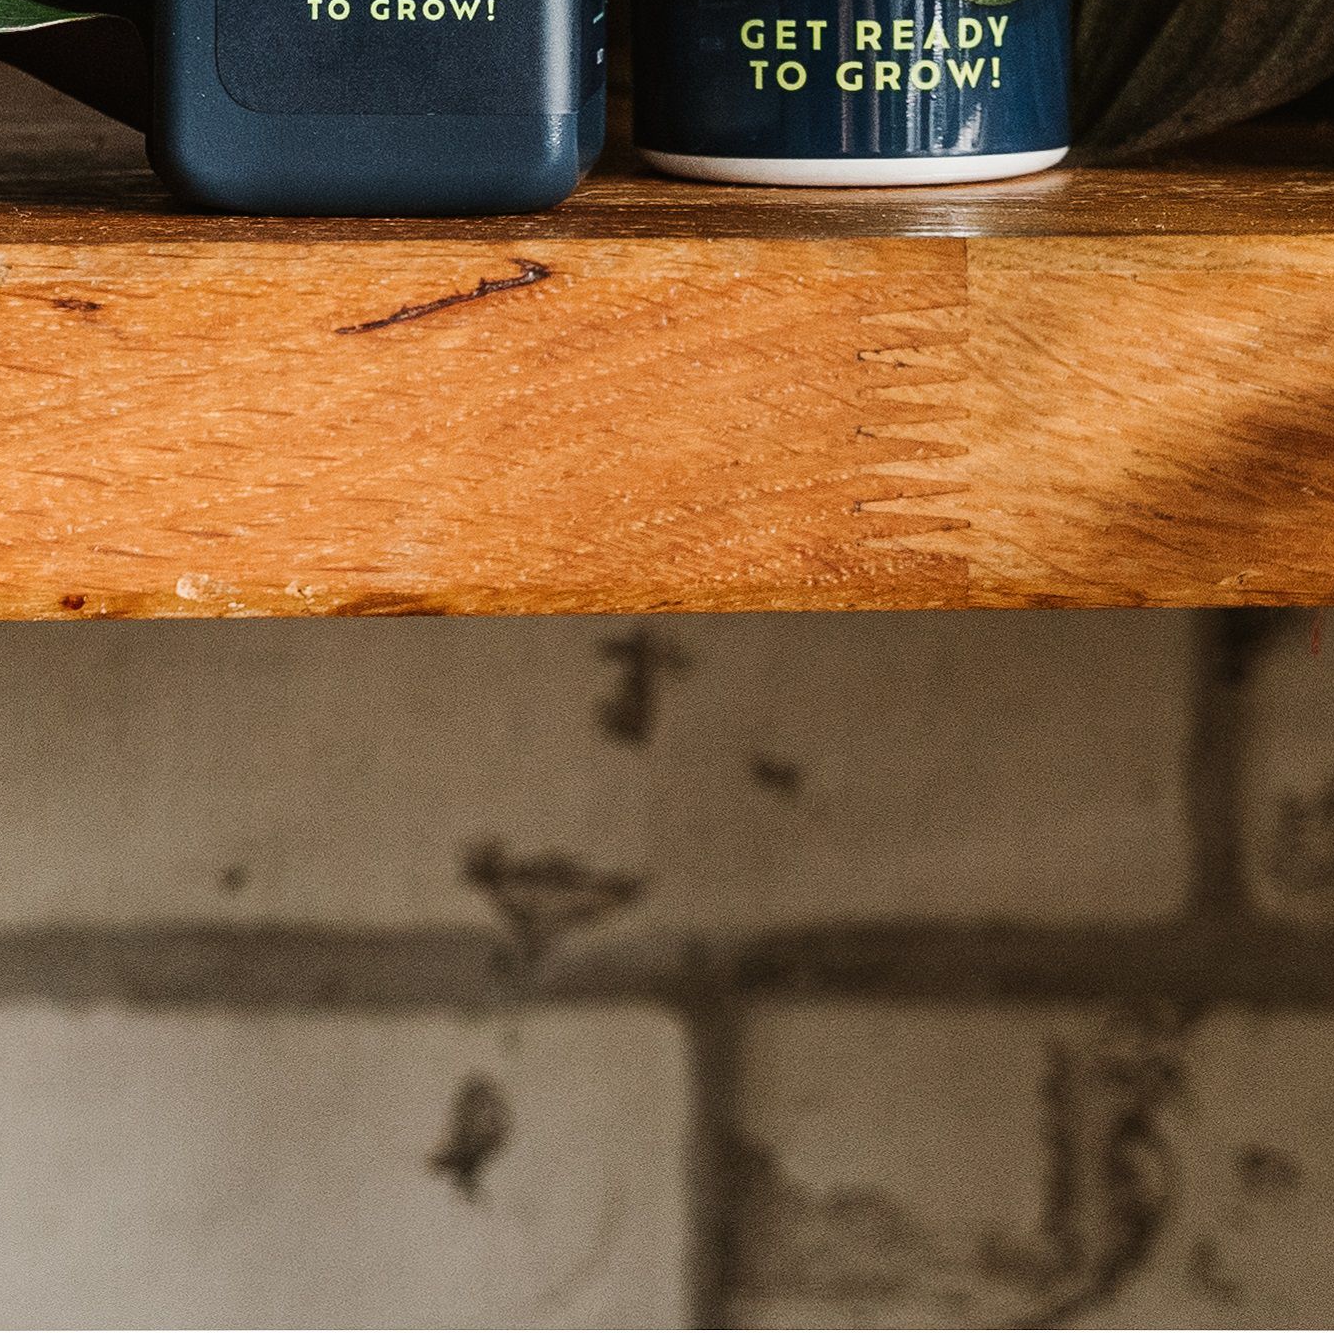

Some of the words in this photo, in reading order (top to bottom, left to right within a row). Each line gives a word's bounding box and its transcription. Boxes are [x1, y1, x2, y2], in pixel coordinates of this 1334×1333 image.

[740, 19, 827, 50] GET
[856, 16, 1009, 50] READY
[749, 60, 808, 90] TO
[835, 57, 1002, 90] GROW!
